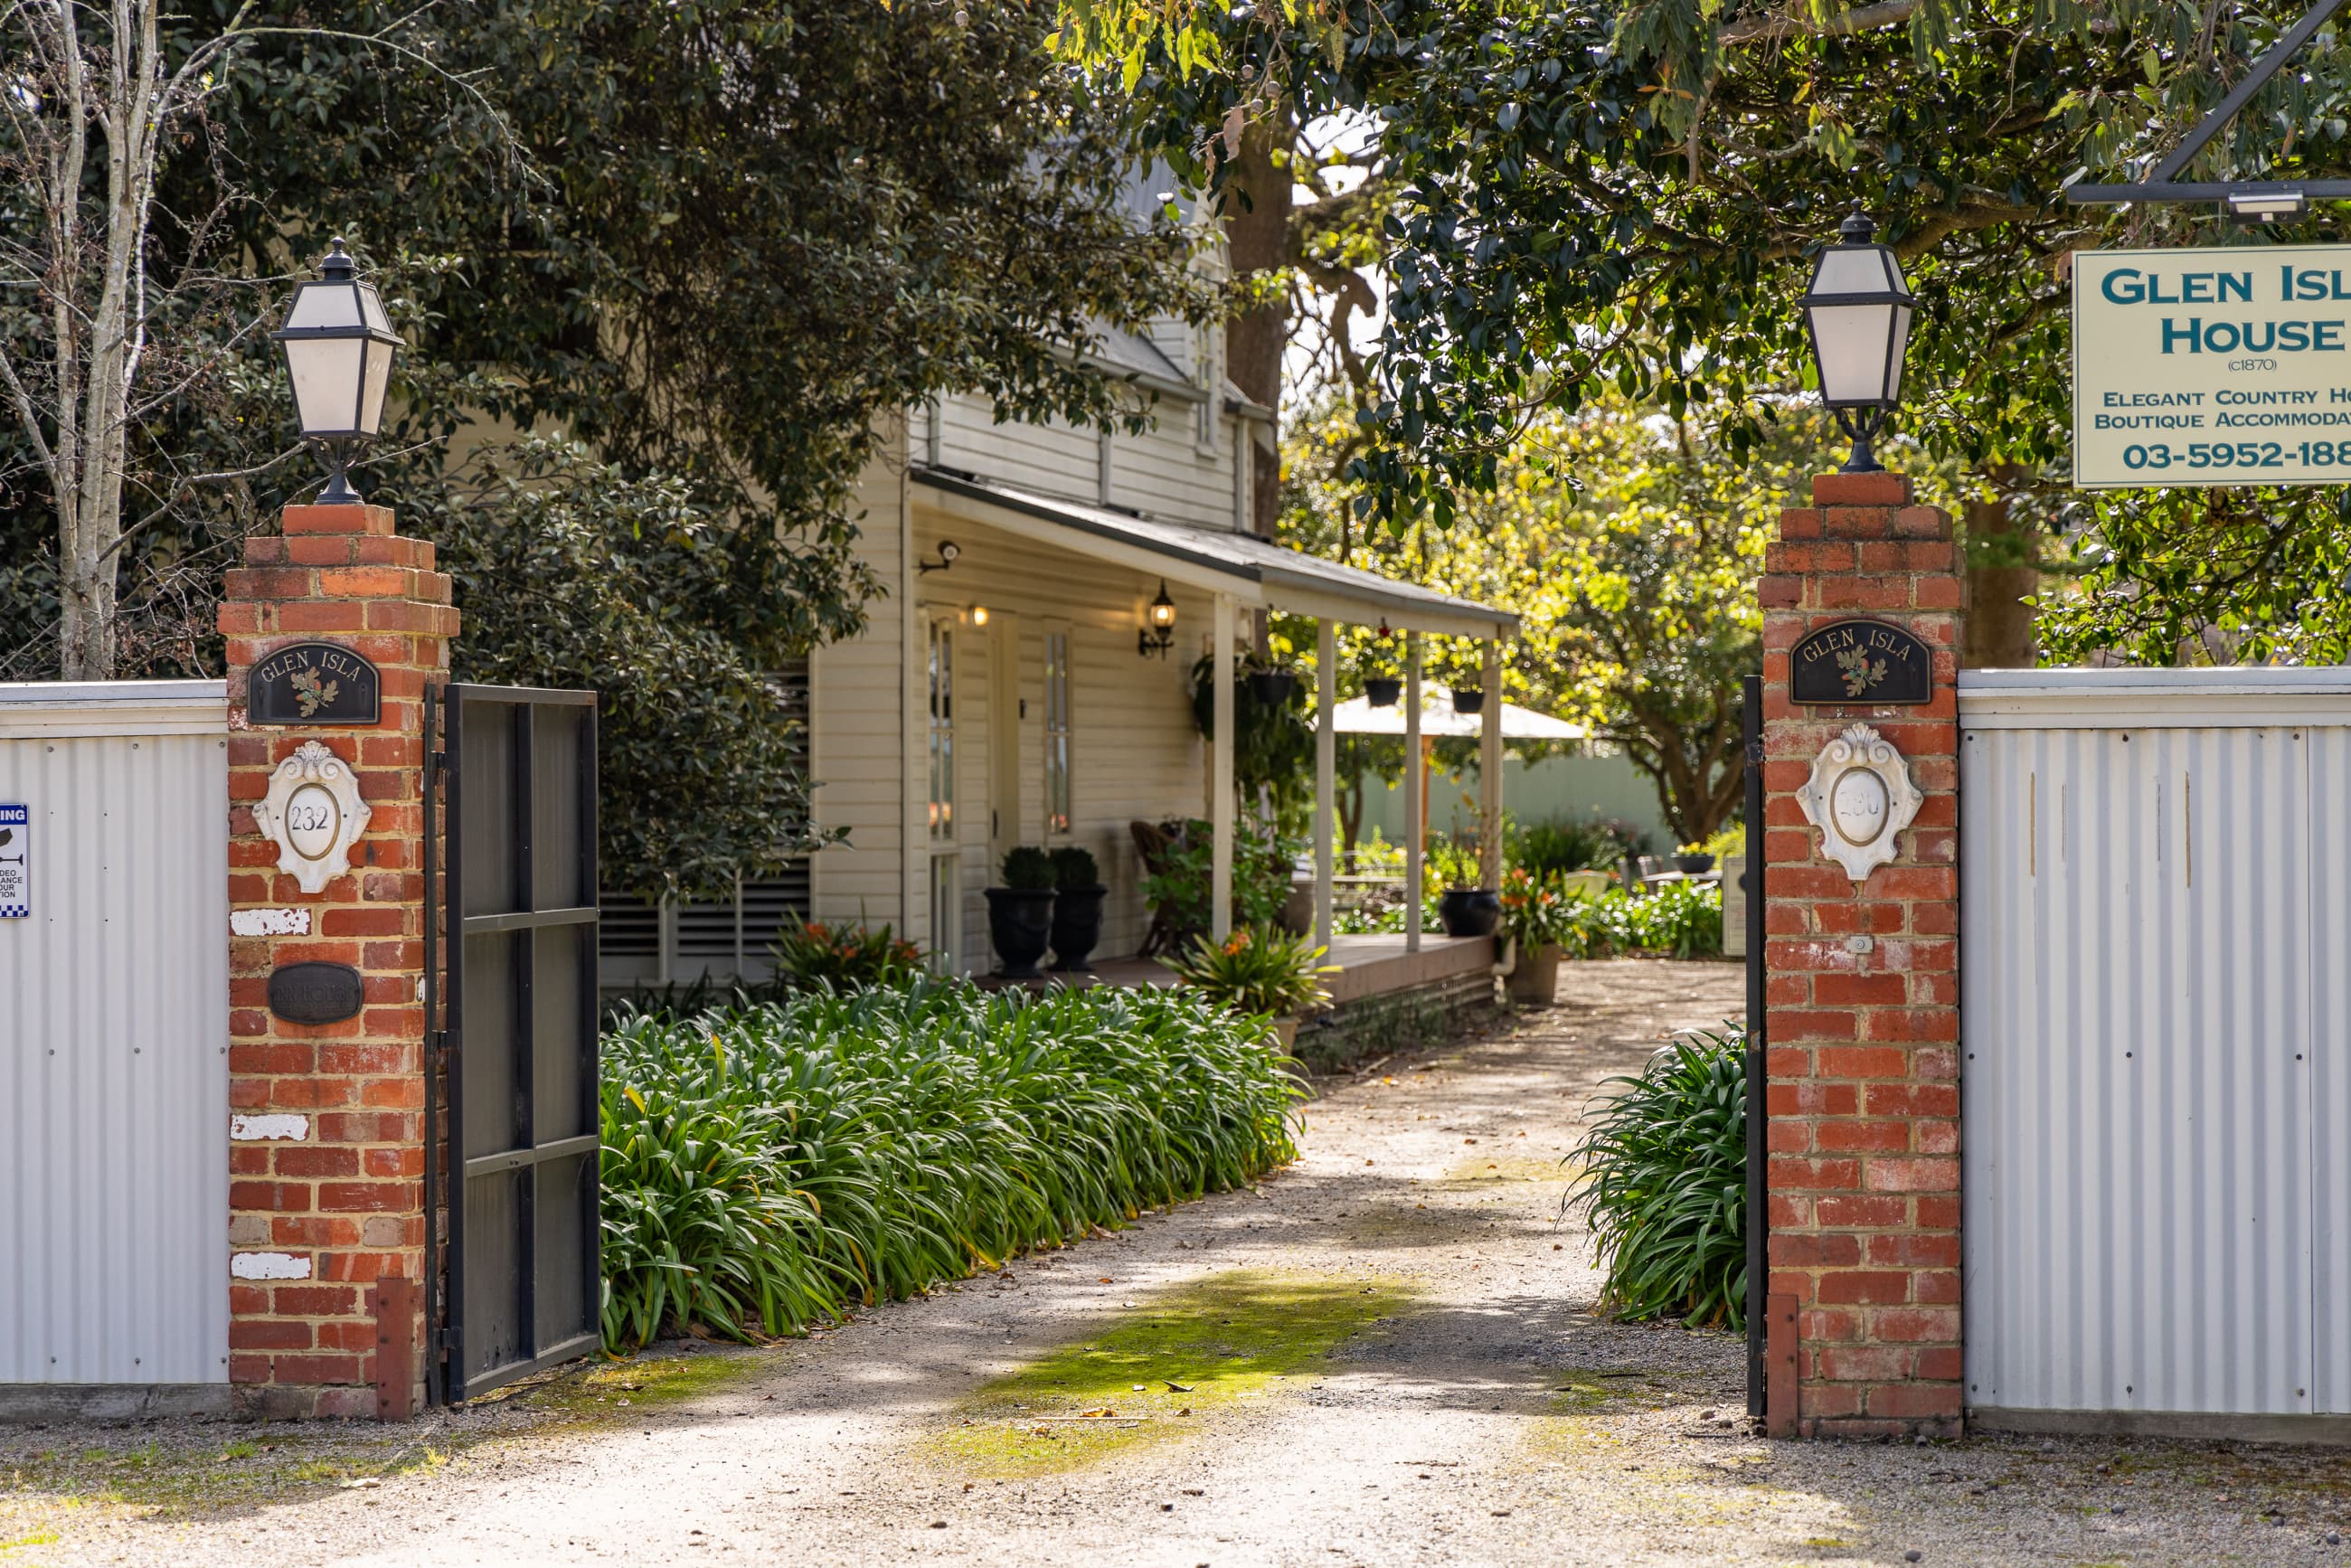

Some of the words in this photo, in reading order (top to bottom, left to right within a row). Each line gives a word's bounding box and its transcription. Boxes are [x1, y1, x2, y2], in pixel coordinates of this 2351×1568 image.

[2101, 267, 2253, 306] GLEN
[2160, 316, 2346, 354] HOUSE
[2227, 358, 2277, 372] (c1870)
[2102, 392, 2205, 407] ELEGANT
[2214, 390, 2318, 405] COUNTRY
[2094, 413, 2205, 430] BOUTIQUE
[2214, 411, 2351, 428] ACCOMMODA
[1803, 628, 1855, 663] GLEN
[1869, 629, 1911, 661] ISLA
[260, 651, 309, 683] GLEN
[320, 651, 362, 682] ISLA
[290, 806, 329, 831] 232
